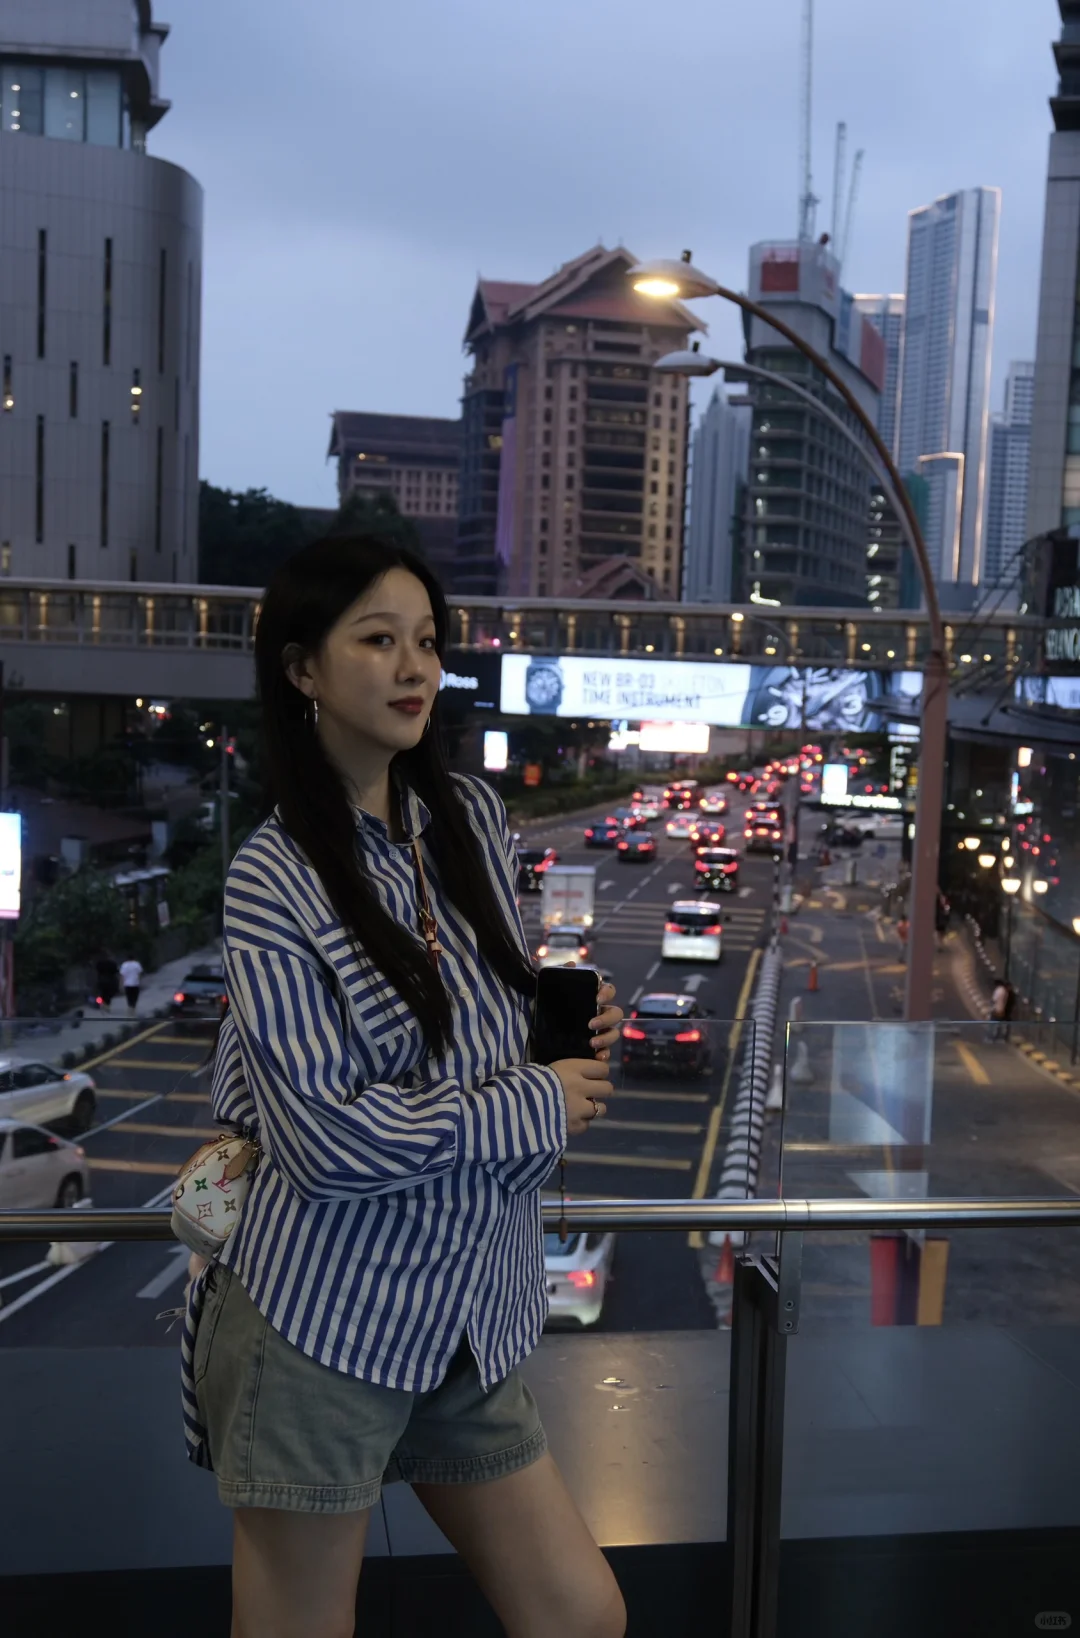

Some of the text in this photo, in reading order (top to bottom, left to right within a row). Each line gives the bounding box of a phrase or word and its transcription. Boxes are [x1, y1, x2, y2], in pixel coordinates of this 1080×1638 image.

[583, 671, 611, 687] NEW
[616, 672, 656, 689] BR-03
[583, 688, 701, 709] TIME INSTRUMENT
[841, 694, 863, 716] 3
[767, 704, 789, 727] 9
